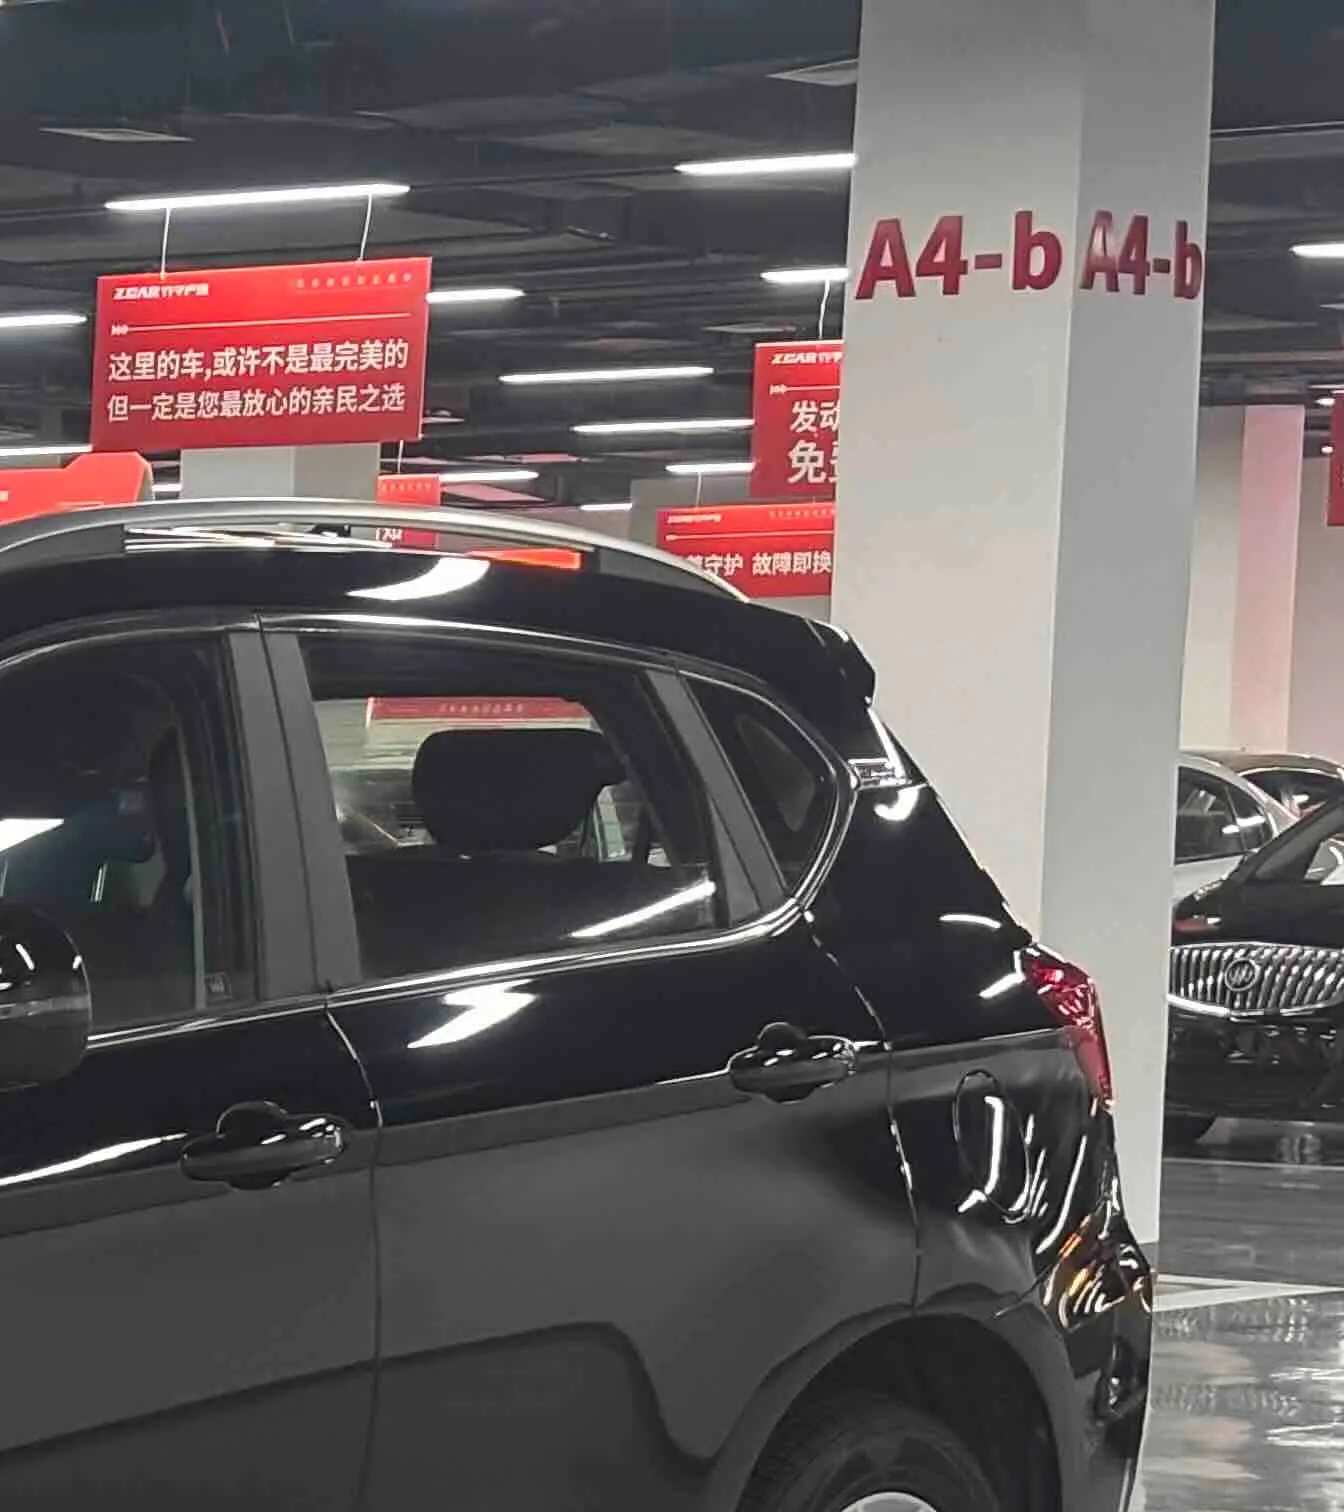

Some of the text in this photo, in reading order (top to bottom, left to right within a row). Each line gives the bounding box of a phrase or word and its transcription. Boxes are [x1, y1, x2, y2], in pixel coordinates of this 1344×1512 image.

[855, 210, 1062, 299] A4-b
[1079, 210, 1203, 299] A4-b
[107, 383, 405, 423] 但一定是您最放心的亲民之选
[788, 440, 839, 484] 免
[751, 551, 832, 576] 故障即换
